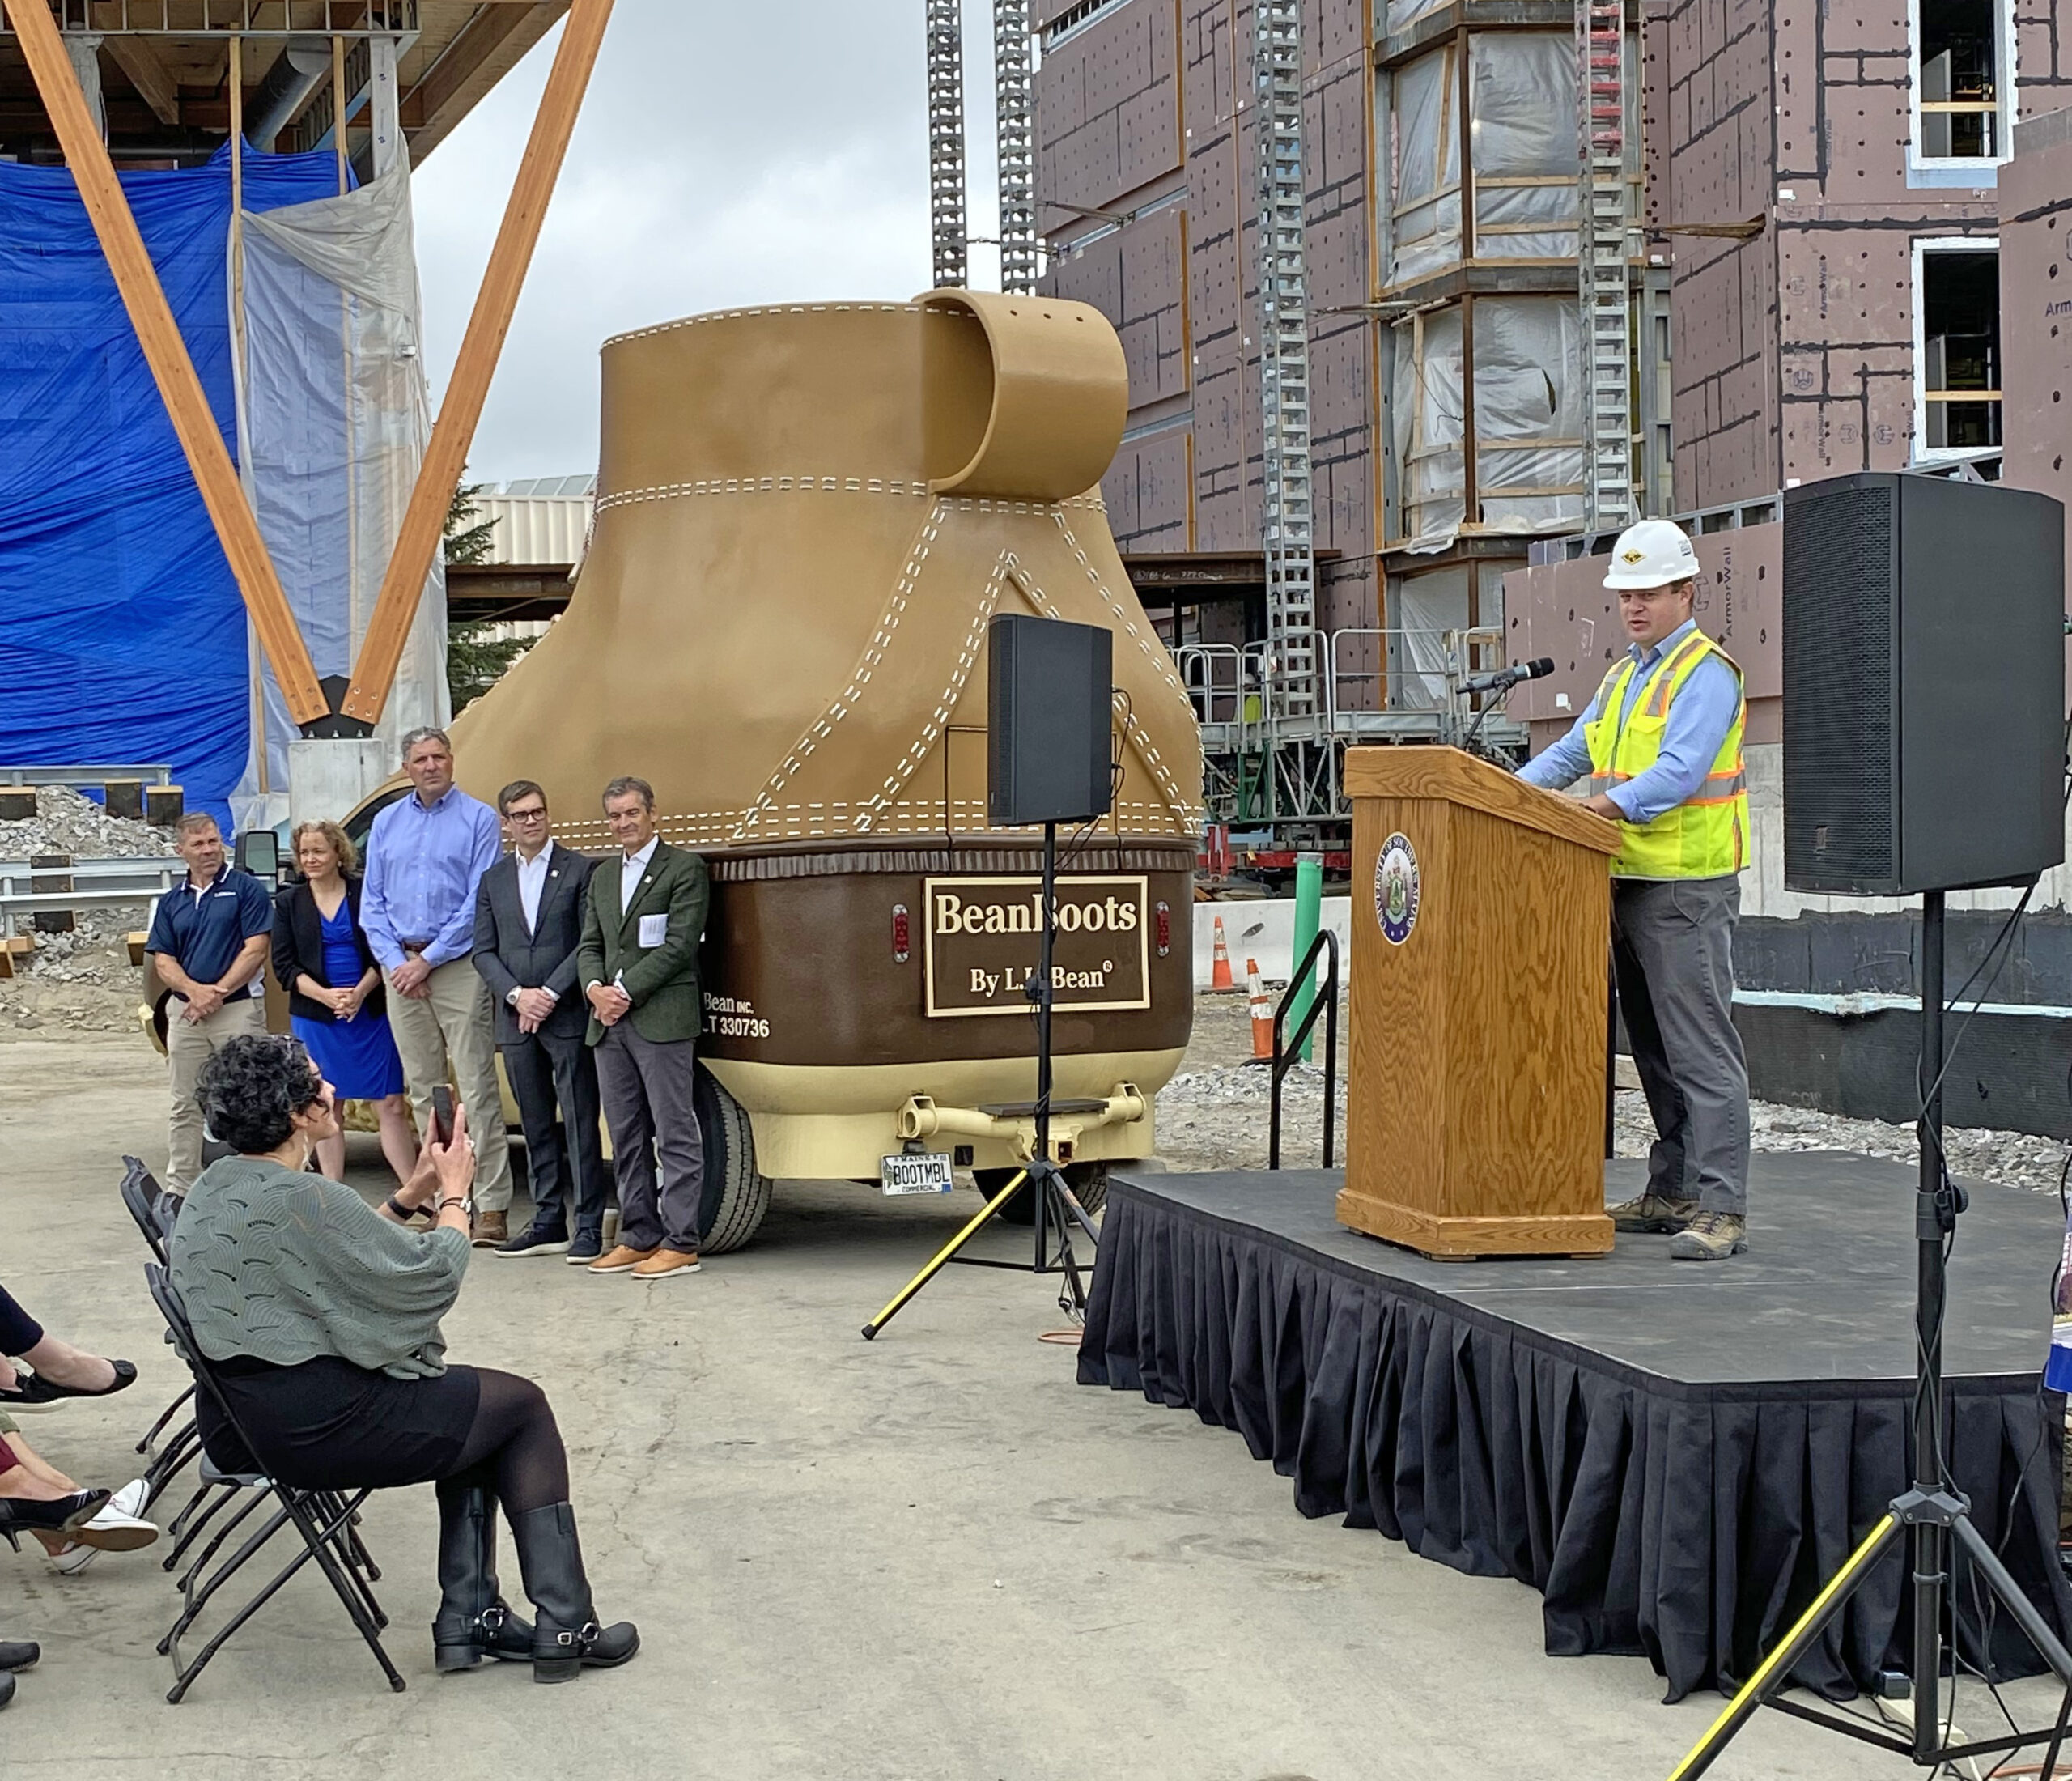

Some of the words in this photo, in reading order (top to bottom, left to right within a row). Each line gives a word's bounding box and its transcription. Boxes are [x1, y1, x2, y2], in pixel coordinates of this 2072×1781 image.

[1723, 546, 1733, 637] ArmorWall
[936, 894, 1137, 933] BeanBoots
[971, 968, 1000, 997] By
[703, 992, 735, 1013] Bean
[720, 1016, 771, 1038] 330736
[893, 1163, 951, 1185] BOOTMBL
